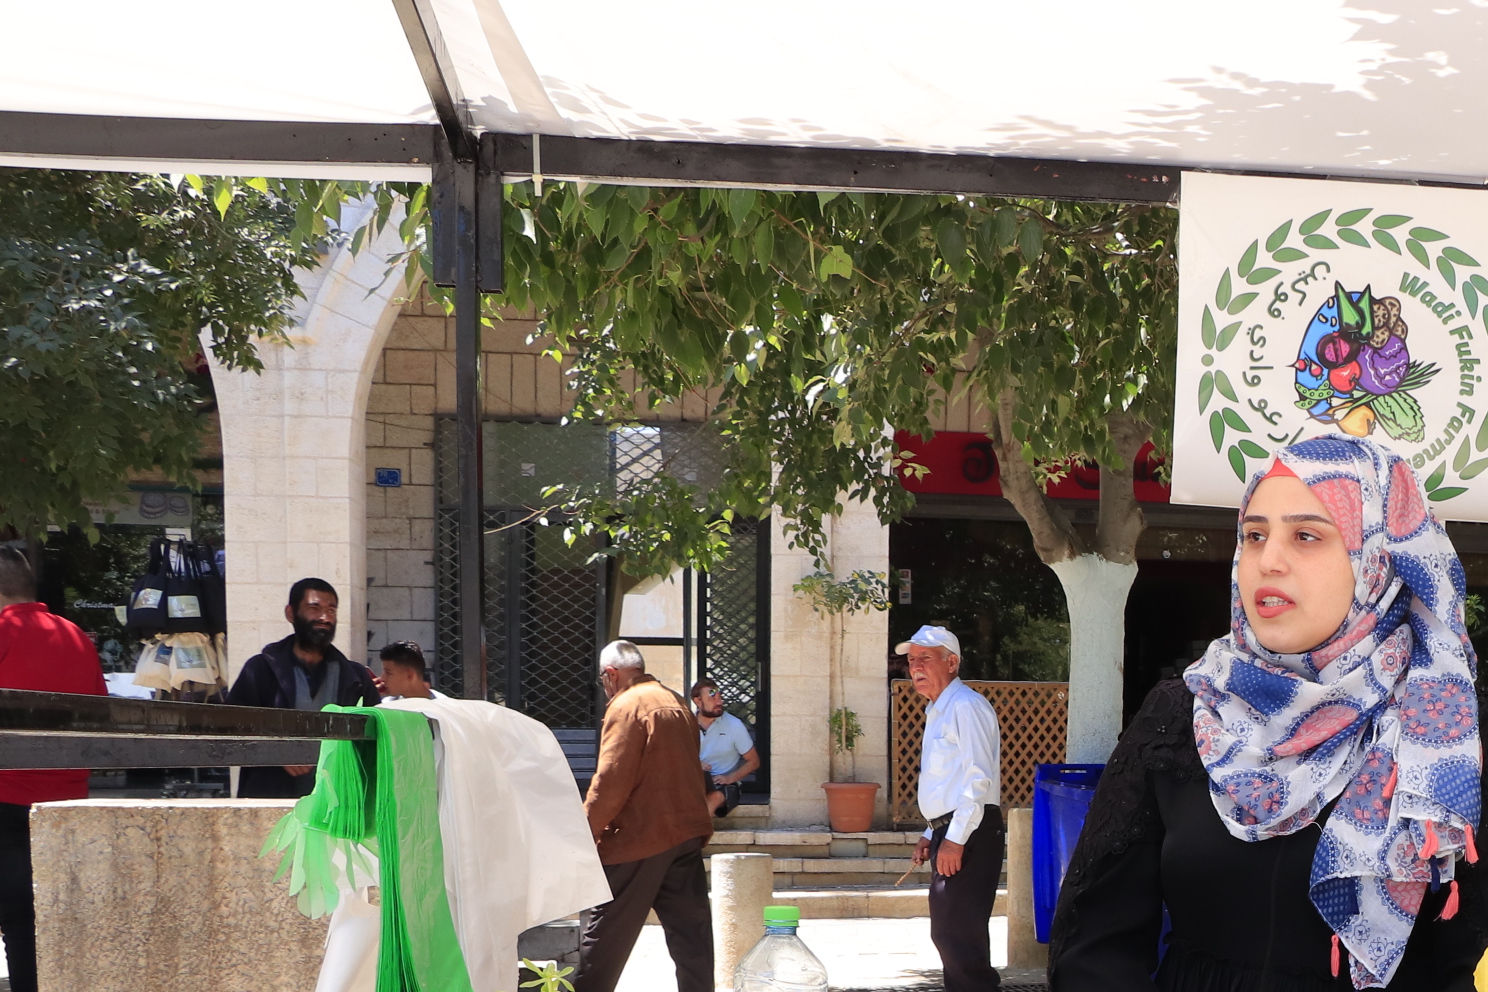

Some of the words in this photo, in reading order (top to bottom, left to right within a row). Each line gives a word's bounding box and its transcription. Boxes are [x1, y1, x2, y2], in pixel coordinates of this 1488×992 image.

[1267, 261, 1331, 320] فوكين
[1399, 271, 1462, 325] Wadi
[1242, 323, 1274, 388] وادي
[1449, 325, 1482, 397] Fukin
[1247, 397, 1305, 446] ارعو
[1405, 401, 1476, 469] Farme
[73, 599, 116, 609] Christma
